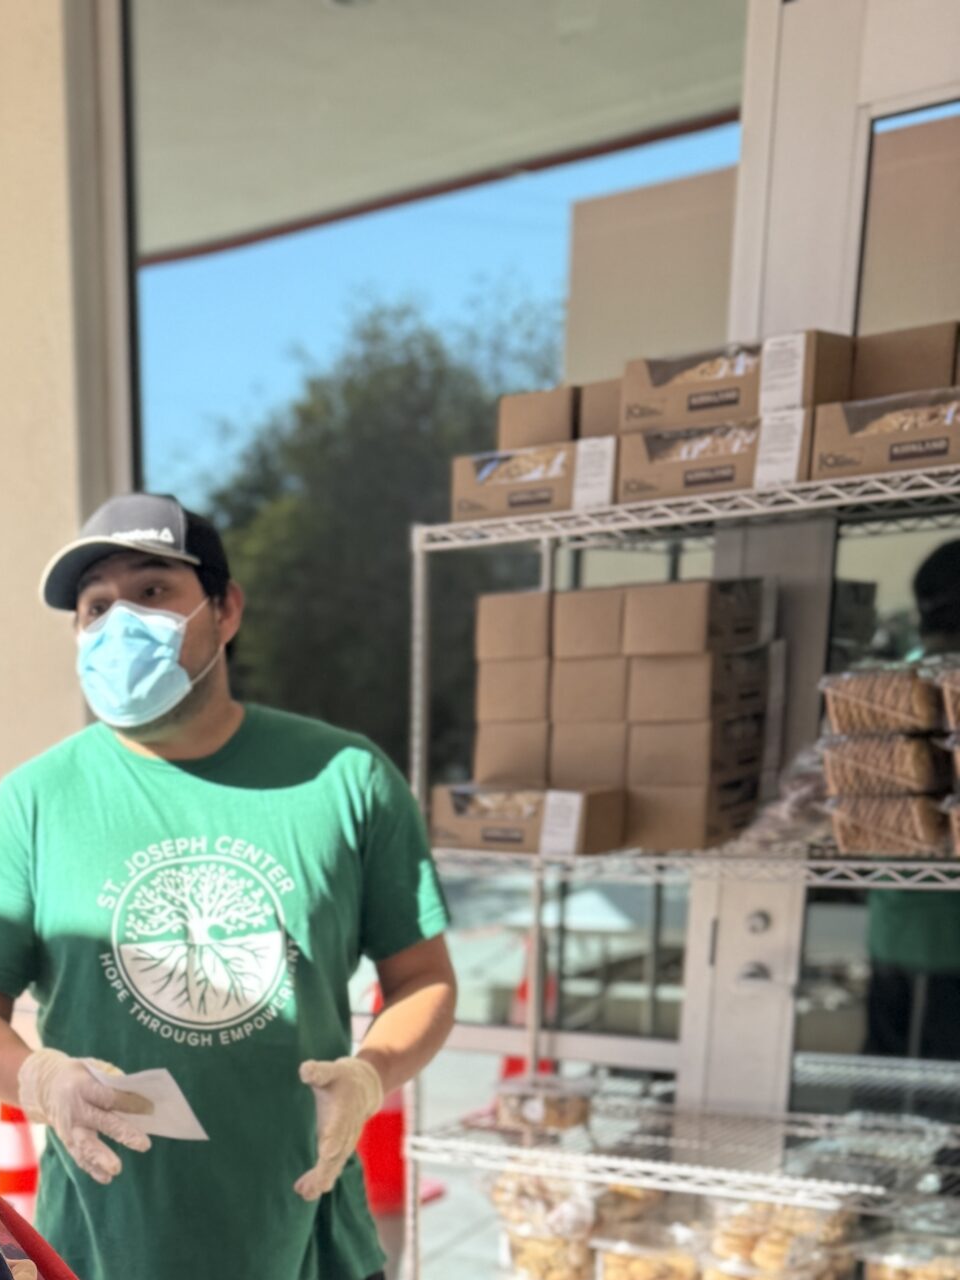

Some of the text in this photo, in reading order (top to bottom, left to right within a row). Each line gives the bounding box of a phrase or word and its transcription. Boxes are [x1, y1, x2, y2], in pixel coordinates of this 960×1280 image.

[96, 835, 295, 910] ST. JOSEPH CENTER
[99, 953, 131, 1003] HOPE
[129, 1003, 213, 1048] THROUGH
